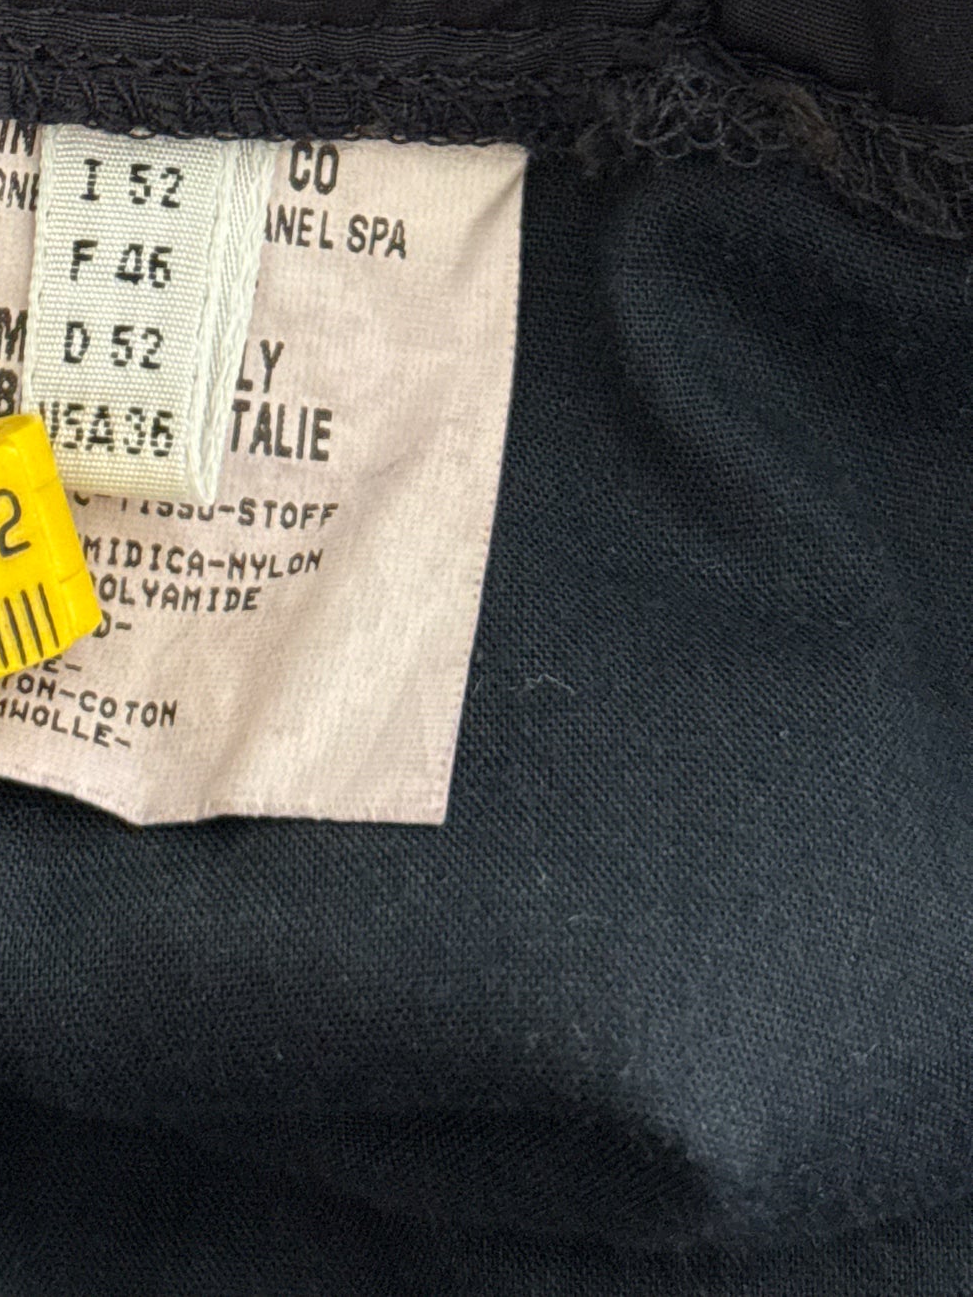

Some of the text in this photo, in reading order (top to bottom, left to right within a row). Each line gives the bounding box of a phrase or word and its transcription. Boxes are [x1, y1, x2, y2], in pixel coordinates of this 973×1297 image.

[80, 159, 184, 208] I 52
[289, 140, 339, 195] CO
[265, 203, 334, 250] NEL
[347, 214, 407, 260] SPA
[70, 239, 172, 289] F 46
[63, 321, 164, 370] D 52
[235, 340, 285, 394] LY
[231, 399, 332, 461] TALIE
[78, 534, 324, 581] MIDICA-NYLON
[90, 570, 263, 612] OLYAMIDE
